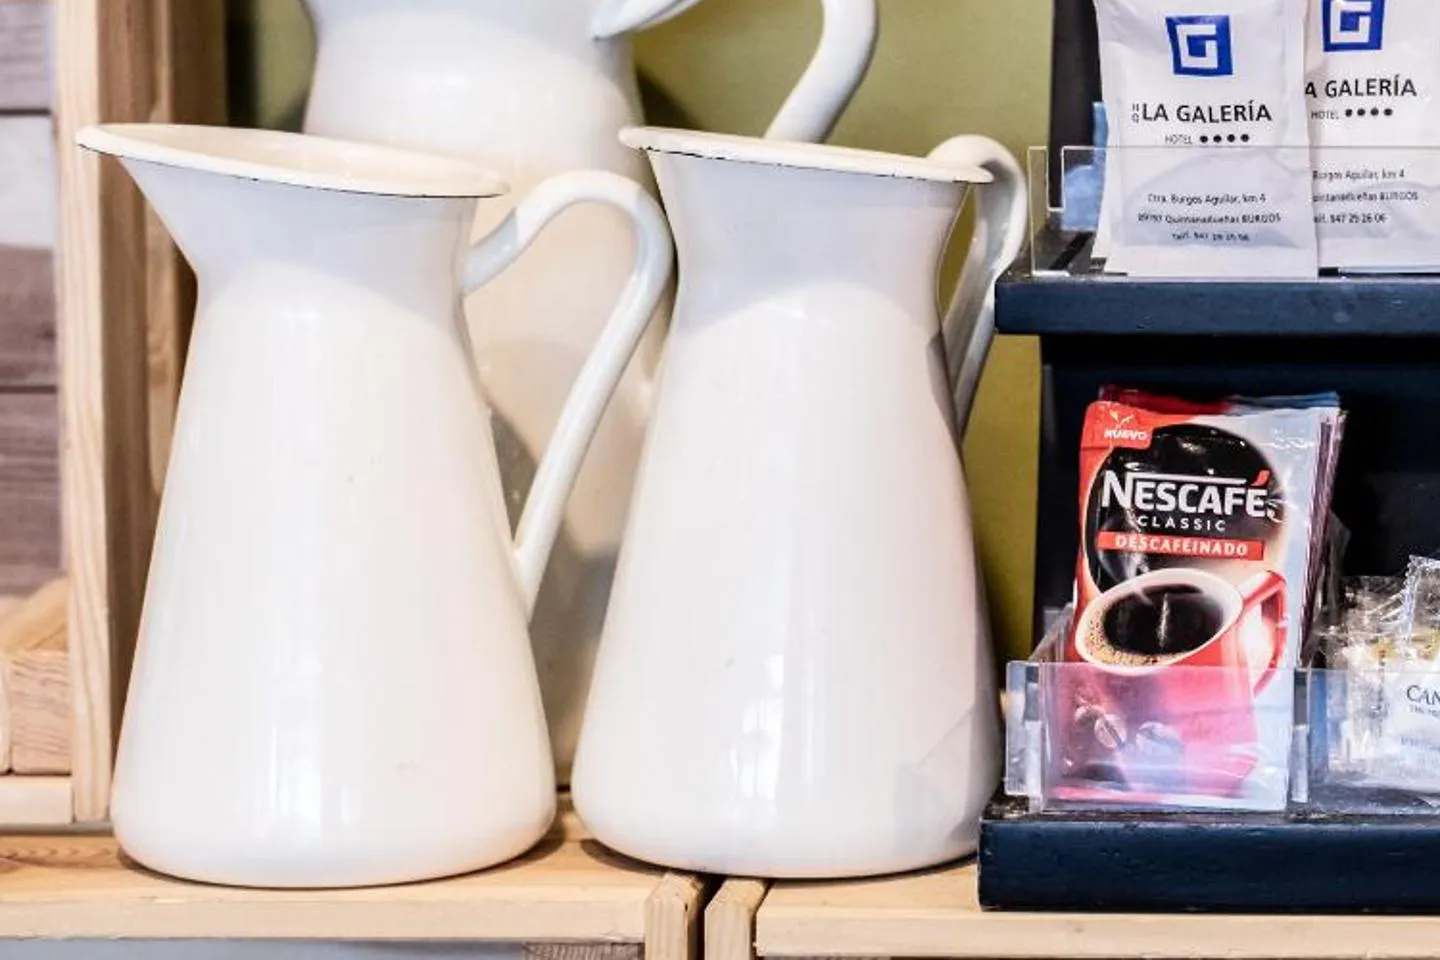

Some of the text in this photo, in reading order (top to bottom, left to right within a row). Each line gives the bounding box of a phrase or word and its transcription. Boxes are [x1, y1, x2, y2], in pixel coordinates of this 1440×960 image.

[1305, 74, 1417, 98] A GALERÍA
[1143, 103, 1169, 121] LA
[1176, 100, 1272, 123] GALERÍA
[1104, 429, 1147, 440] NUEVO
[1138, 516, 1226, 532] CLASSIC
[1115, 535, 1248, 556] DESCAFEINADO
